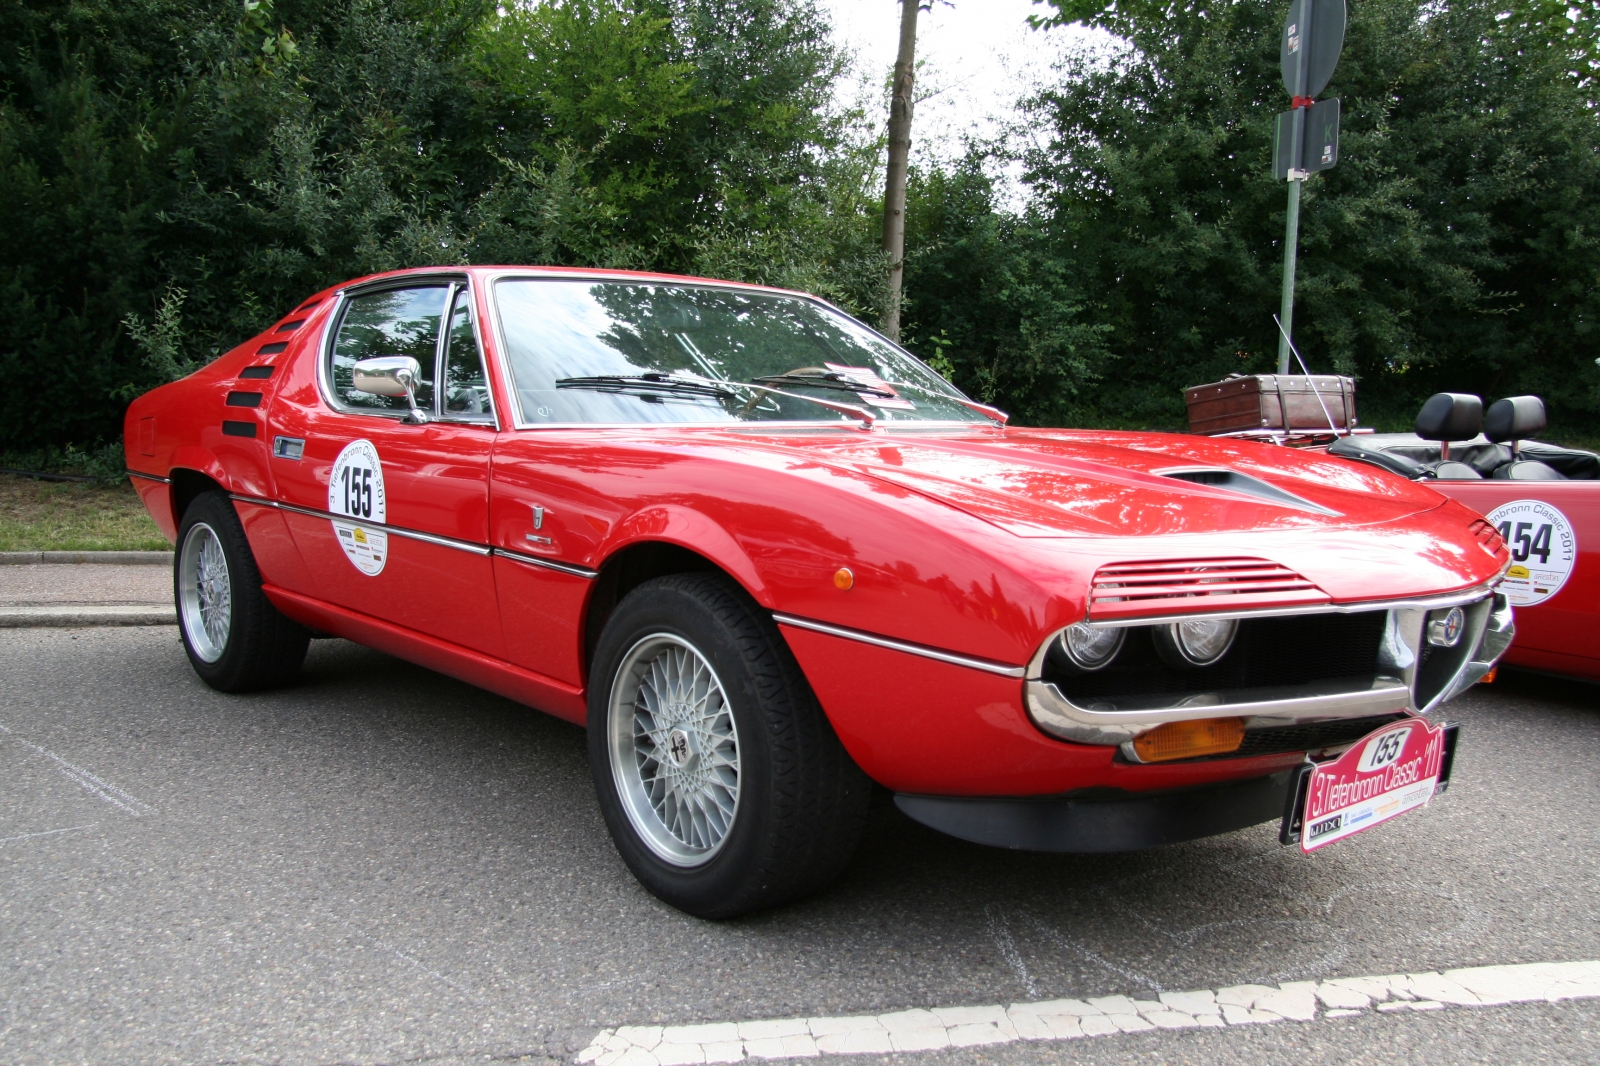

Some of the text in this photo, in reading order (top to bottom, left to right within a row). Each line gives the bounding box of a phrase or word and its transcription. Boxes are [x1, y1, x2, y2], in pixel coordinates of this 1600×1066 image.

[341, 466, 372, 518] 155
[363, 445, 378, 477] Classic
[376, 479, 384, 514] 2011
[1490, 504, 1572, 561] enbronn Classic 2011
[1370, 730, 1406, 767] 155
[1384, 750, 1422, 791] Classic
